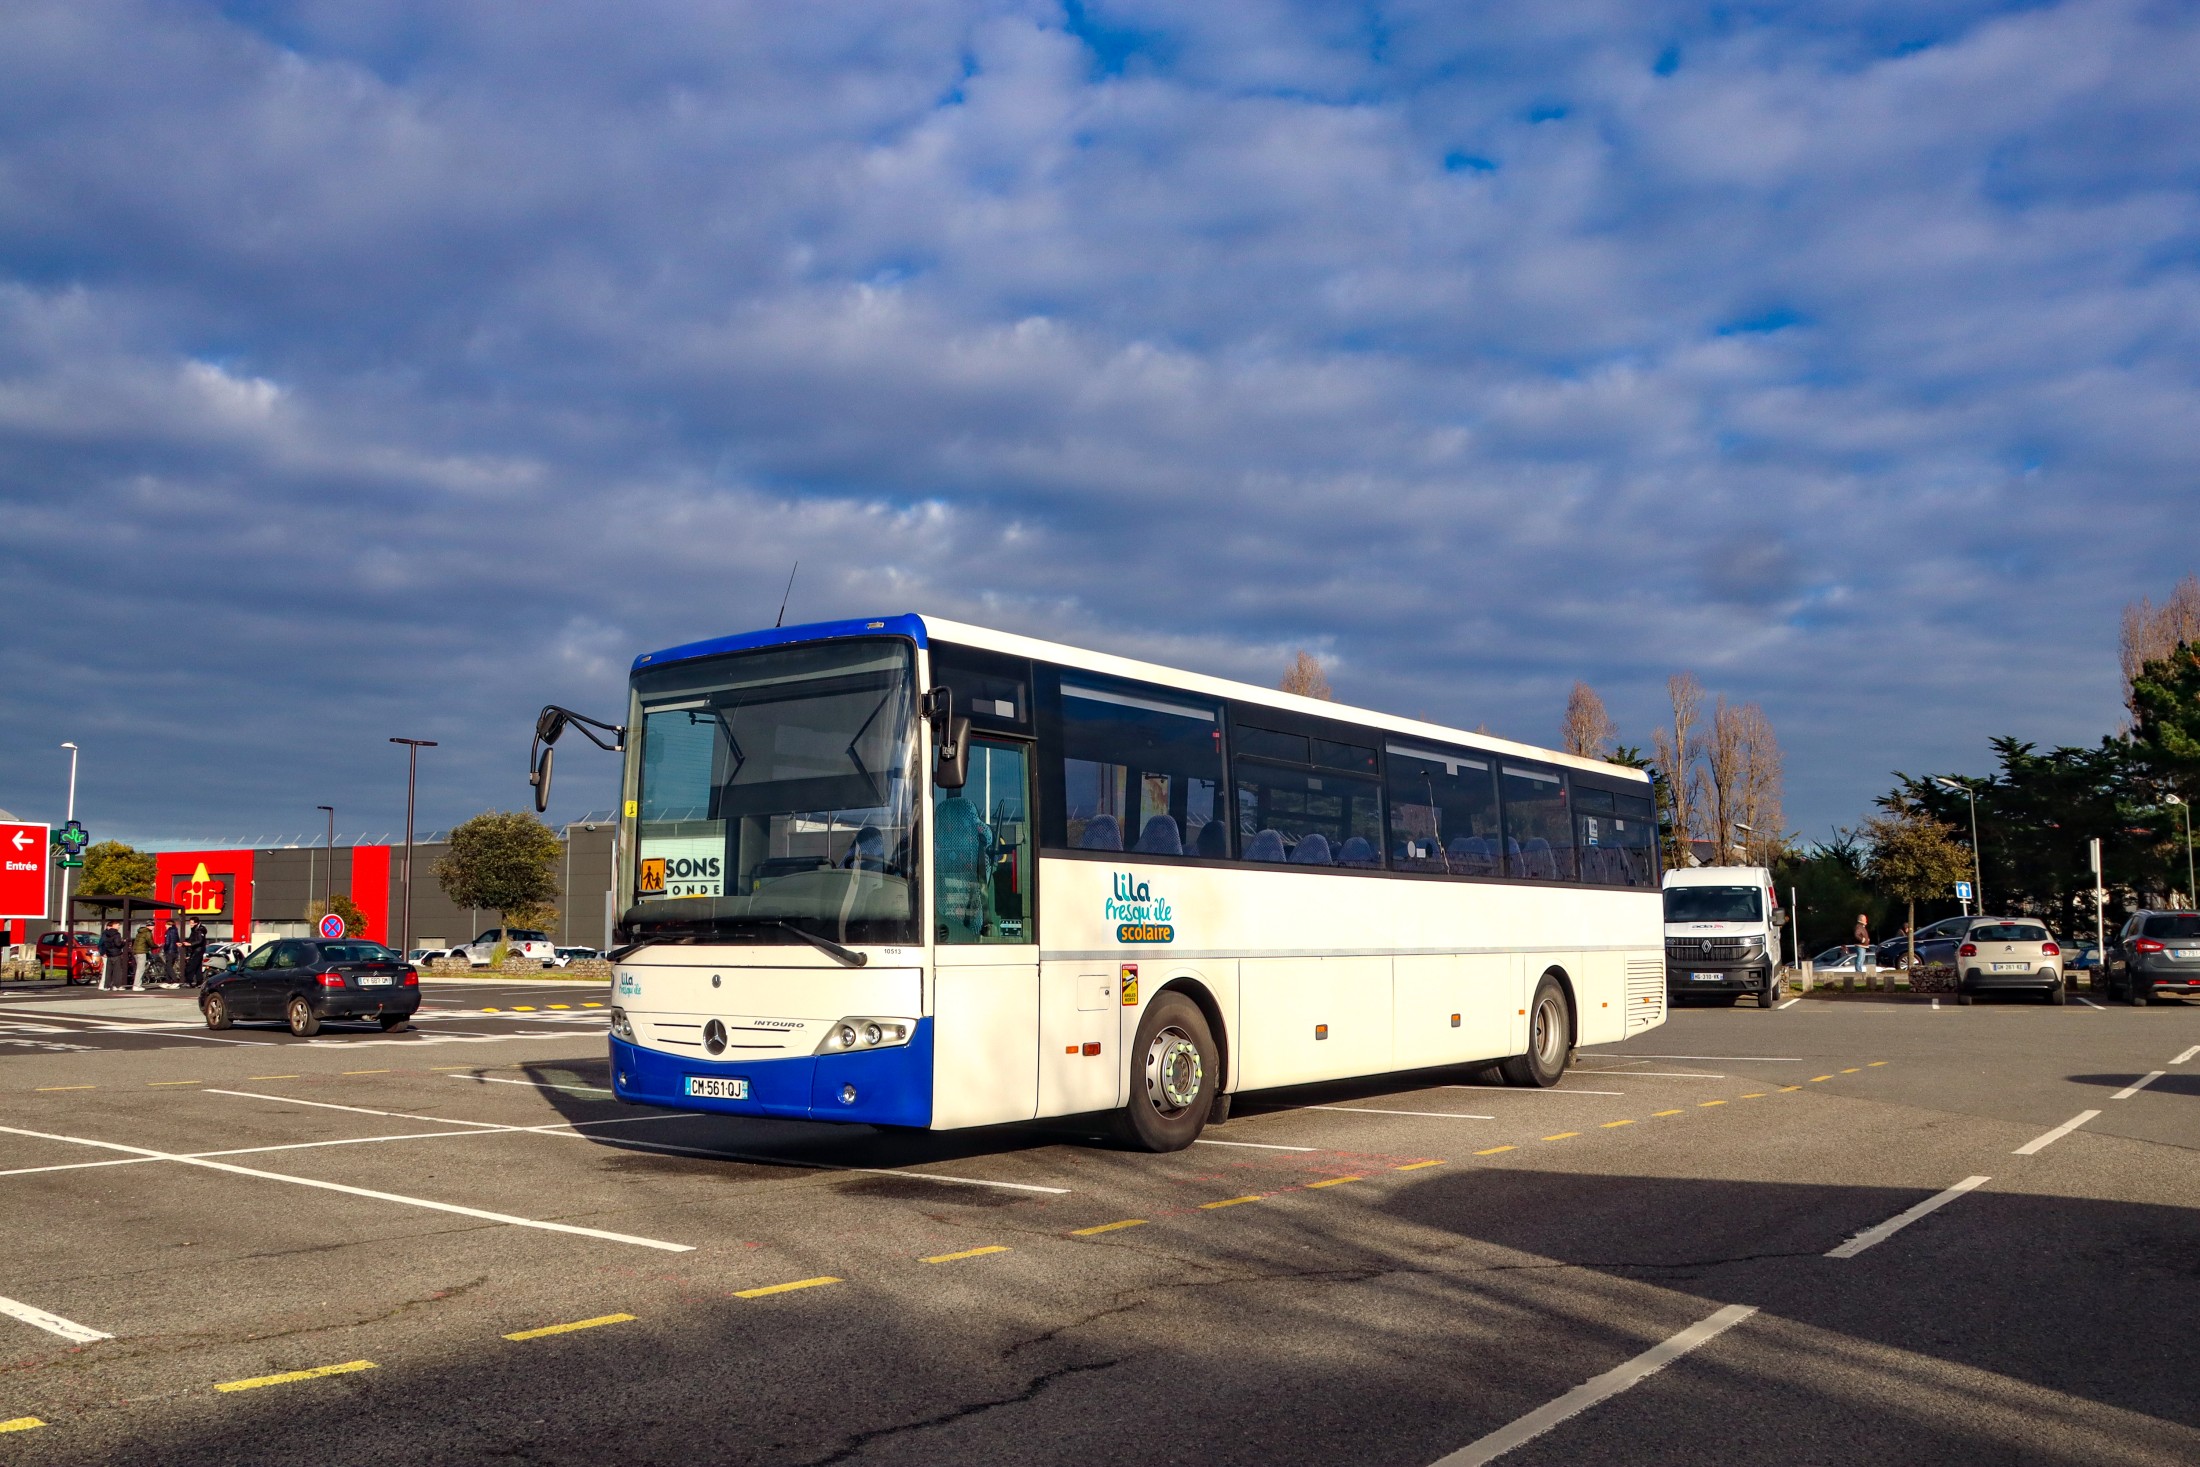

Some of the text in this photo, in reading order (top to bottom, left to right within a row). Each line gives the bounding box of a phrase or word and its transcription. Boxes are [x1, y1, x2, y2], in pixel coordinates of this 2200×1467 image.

[6, 861, 38, 871] Entrée
[666, 857, 720, 878] SONS
[1121, 921, 1171, 941] scolaire
[753, 1020, 805, 1028] INTOURO
